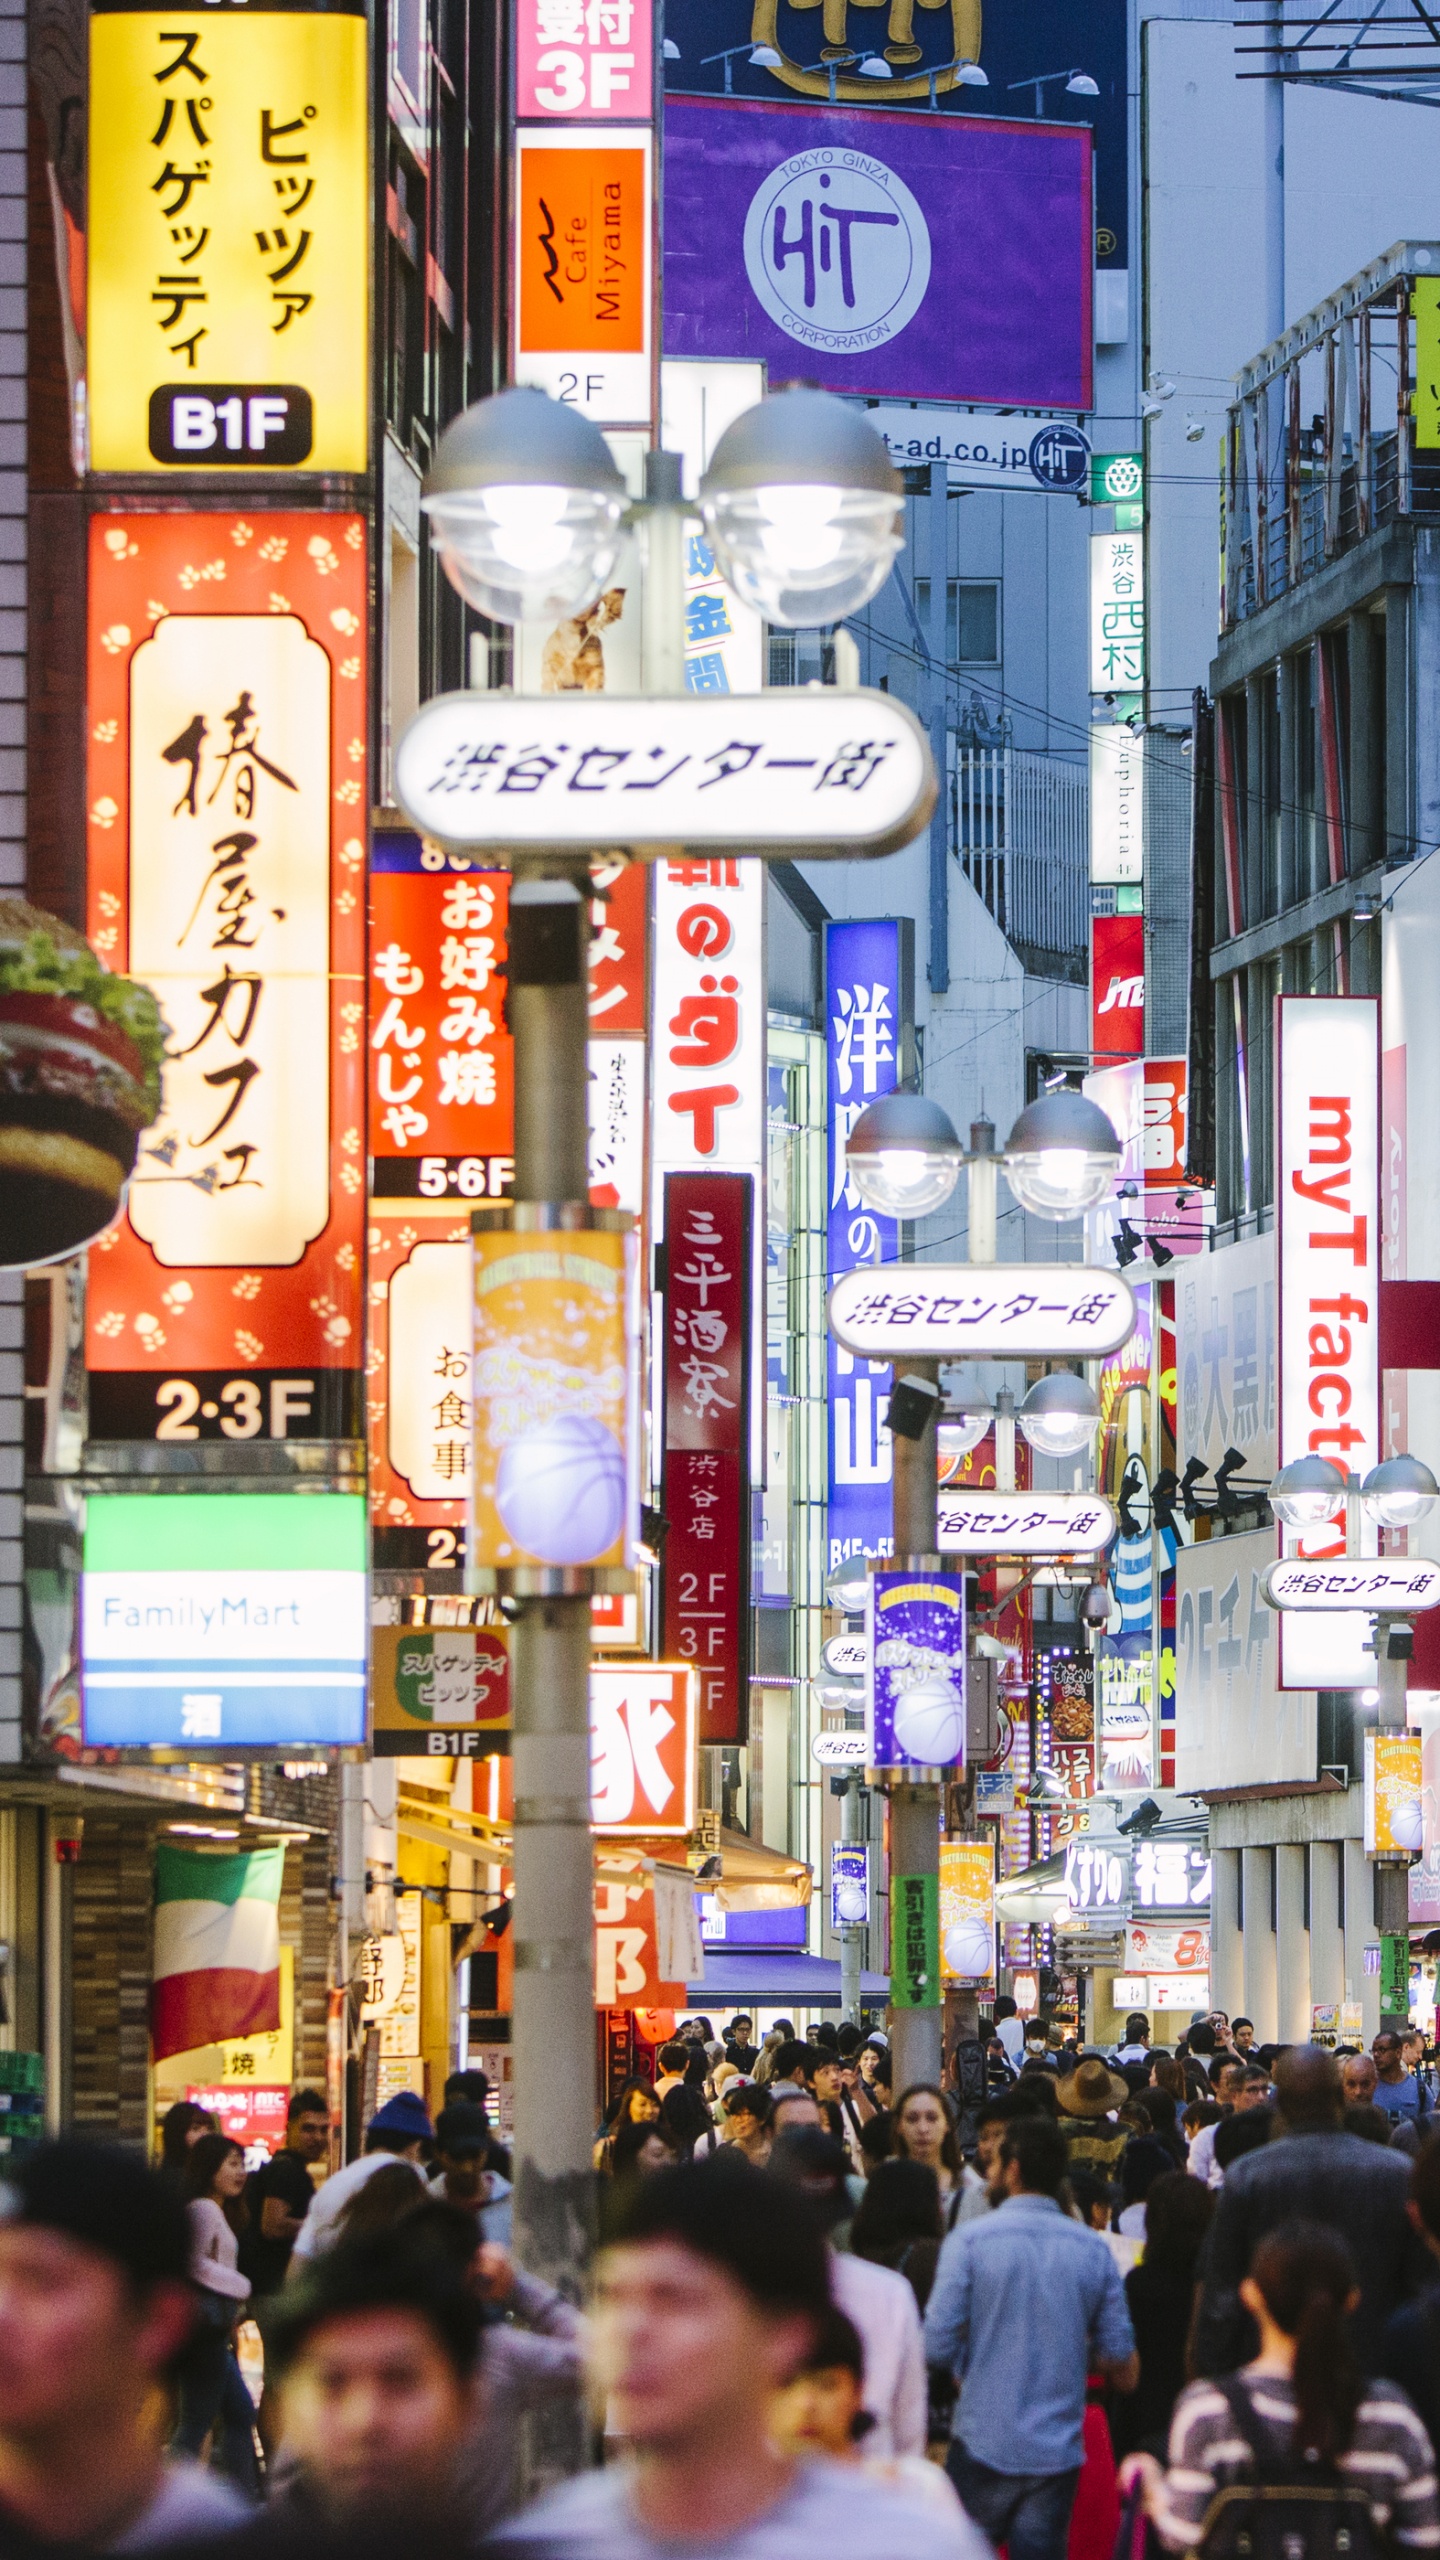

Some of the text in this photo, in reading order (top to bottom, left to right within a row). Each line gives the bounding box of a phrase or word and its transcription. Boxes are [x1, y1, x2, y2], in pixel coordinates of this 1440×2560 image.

[535, 50, 634, 111] 3F
[779, 151, 889, 186] TOKYO GINZA
[150, 32, 213, 368] スパゲッティ
[255, 105, 318, 332] ピッツァ
[565, 216, 588, 284] Cafe
[595, 181, 627, 322] Miyama
[782, 314, 891, 348] CORPORATION
[558, 373, 605, 402] 2F
[171, 397, 289, 450] B1F
[427, 739, 898, 793] 渋谷センター街
[161, 690, 300, 1190] 椿屋カフェ
[438, 880, 497, 1106] お好み焼
[1292, 1096, 1368, 1267] myT
[844, 1293, 1117, 1325] 渋谷センター街
[688, 1455, 719, 1540] 渋谷店
[938, 1511, 1101, 1535] 谷センター街
[678, 1573, 726, 1603] 2F
[1277, 1574, 1436, 1593] 渋谷センター街
[103, 1597, 301, 1634] FamilyMart
[678, 1627, 726, 1657] 3F
[181, 1693, 223, 1738] 酒
[427, 1732, 479, 1756] B1F
